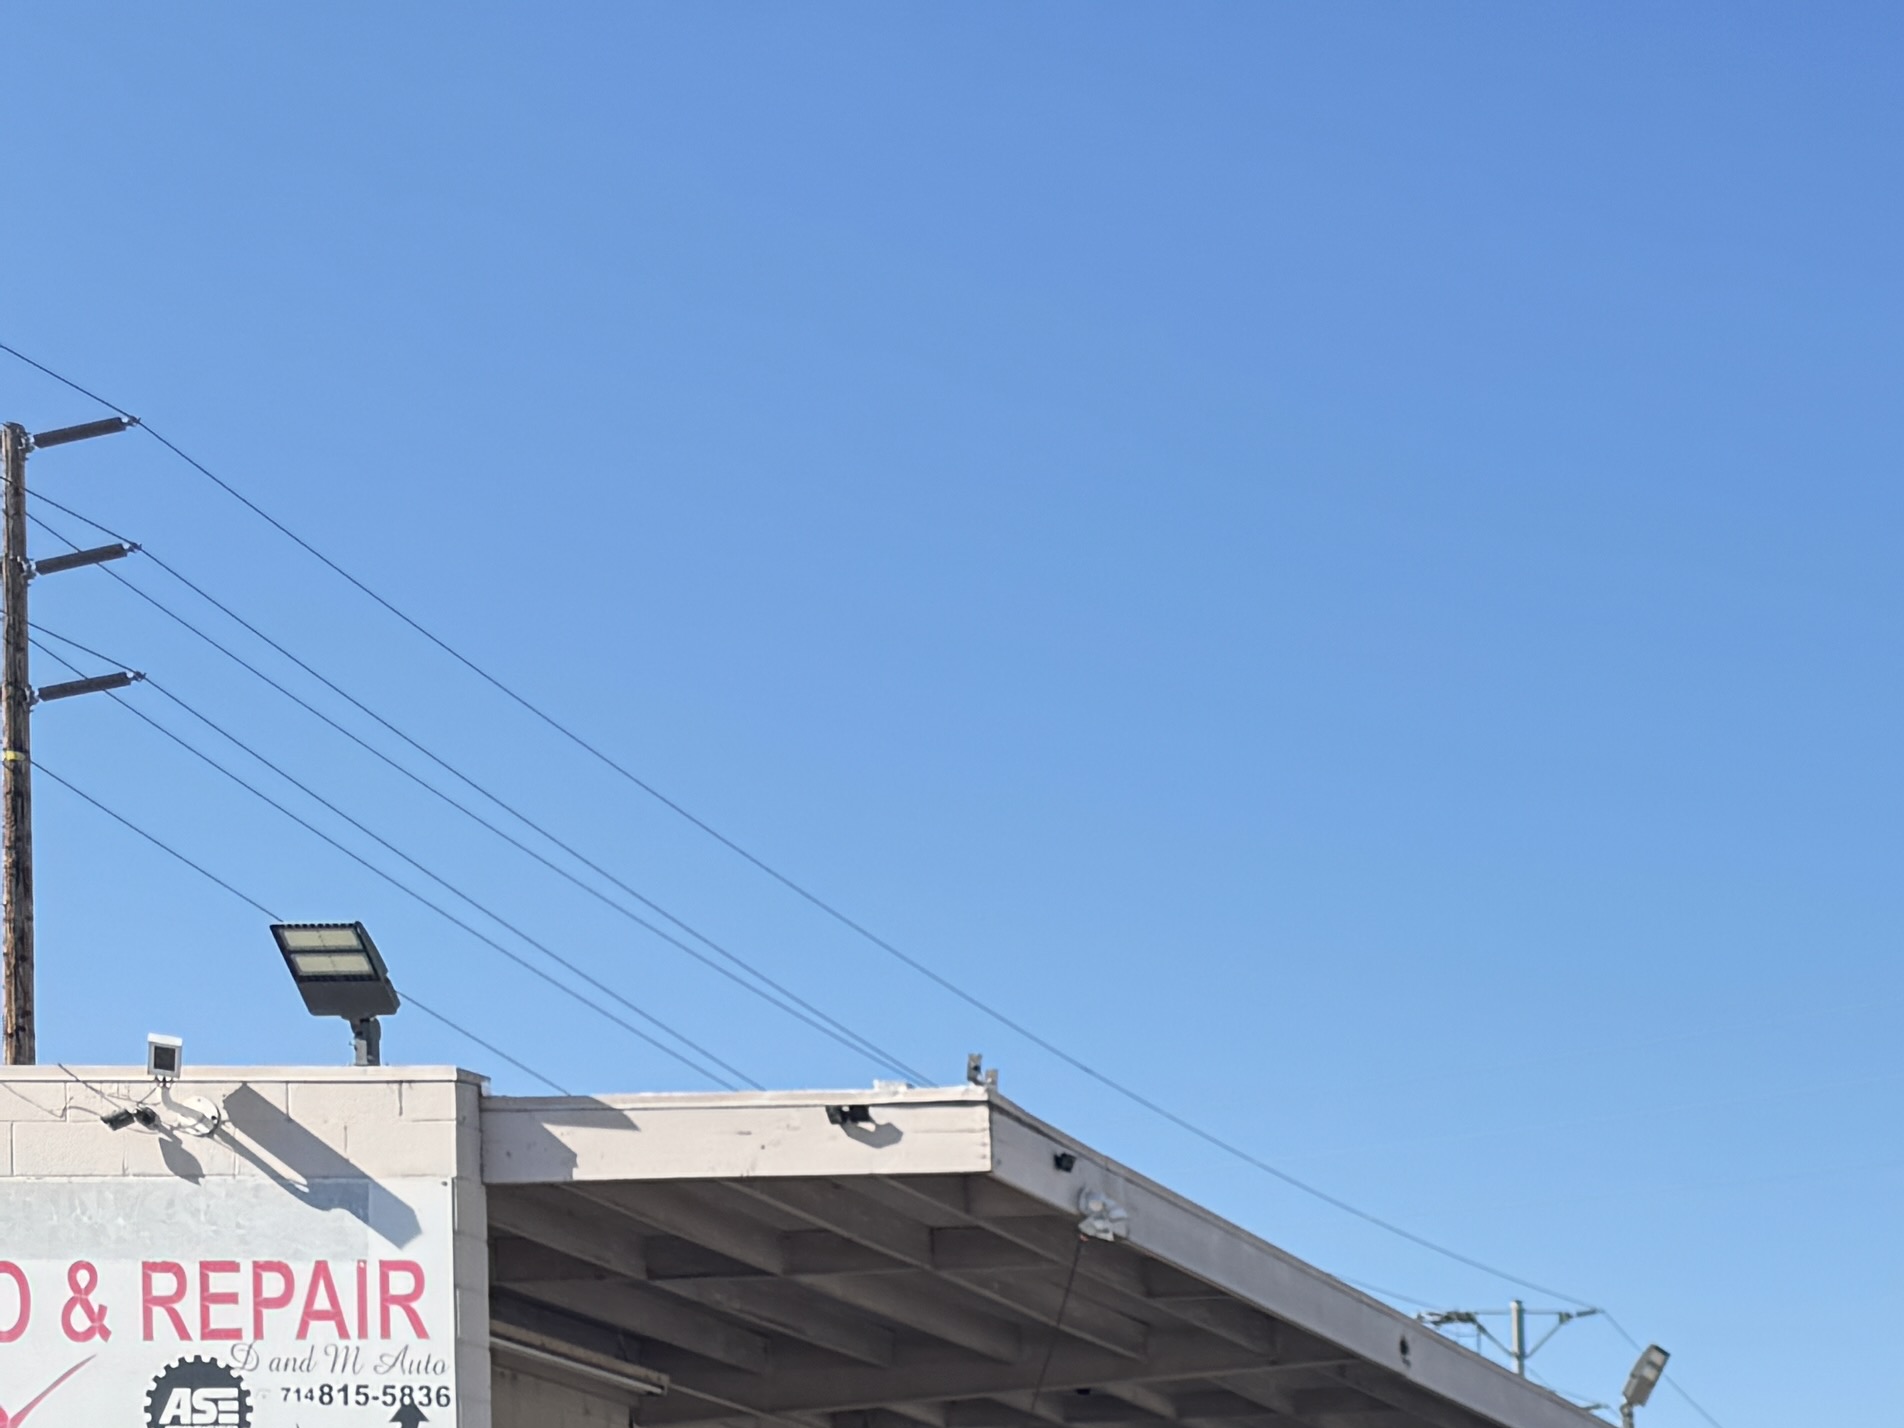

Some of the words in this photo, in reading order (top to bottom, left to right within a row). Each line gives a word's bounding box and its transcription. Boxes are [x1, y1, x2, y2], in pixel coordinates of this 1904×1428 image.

[61, 1260, 112, 1343] &
[142, 1259, 430, 1342] REPAIR
[230, 1340, 260, 1373] D
[268, 1344, 317, 1374] and
[323, 1343, 365, 1375] M
[373, 1343, 450, 1376] Auto
[158, 1387, 240, 1425] ASE
